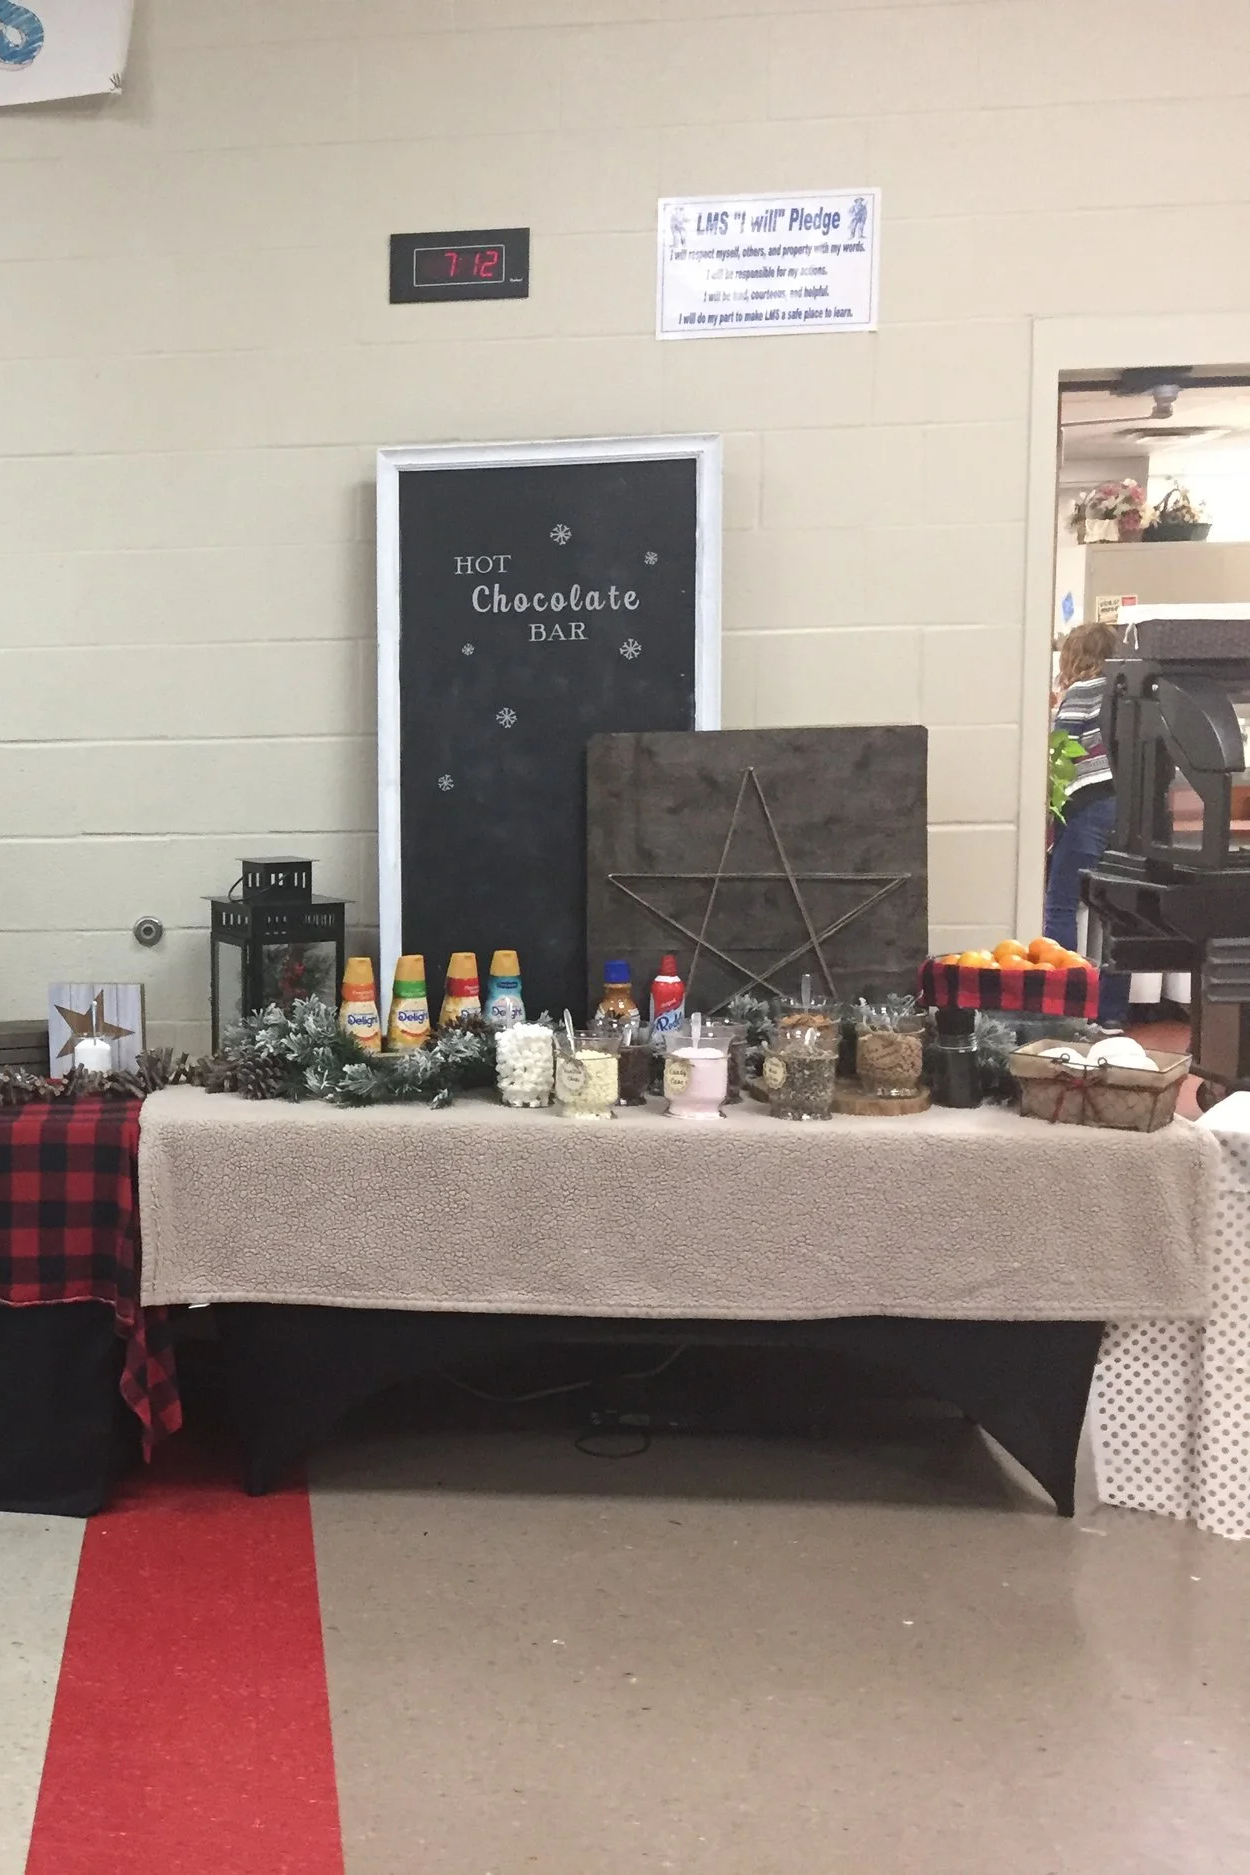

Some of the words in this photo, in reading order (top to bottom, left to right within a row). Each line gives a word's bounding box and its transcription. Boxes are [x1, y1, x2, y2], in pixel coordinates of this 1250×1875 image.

[696, 210, 729, 235] LMS
[789, 206, 841, 236] Pledge
[675, 249, 687, 260] will
[716, 246, 740, 261] myself,
[742, 245, 766, 259] others,
[768, 244, 781, 256] and
[782, 244, 812, 258] property
[831, 244, 841, 256] my
[843, 241, 865, 253] words.
[735, 266, 775, 281] responsible
[777, 266, 786, 278] for
[788, 268, 798, 279] my
[804, 285, 829, 299] helpful.
[684, 312, 695, 324] will
[698, 312, 706, 324] do
[708, 313, 717, 326] my
[719, 311, 734, 325] part
[736, 311, 742, 322] to
[744, 310, 763, 322] make
[765, 309, 780, 321] LMS
[781, 311, 786, 321] a
[788, 308, 802, 320] safe
[804, 307, 823, 322] place
[825, 307, 832, 318] to
[833, 306, 853, 318] learn.
[454, 555, 511, 575] HOT
[472, 583, 639, 613] Chocolate
[528, 622, 588, 641] BAR
